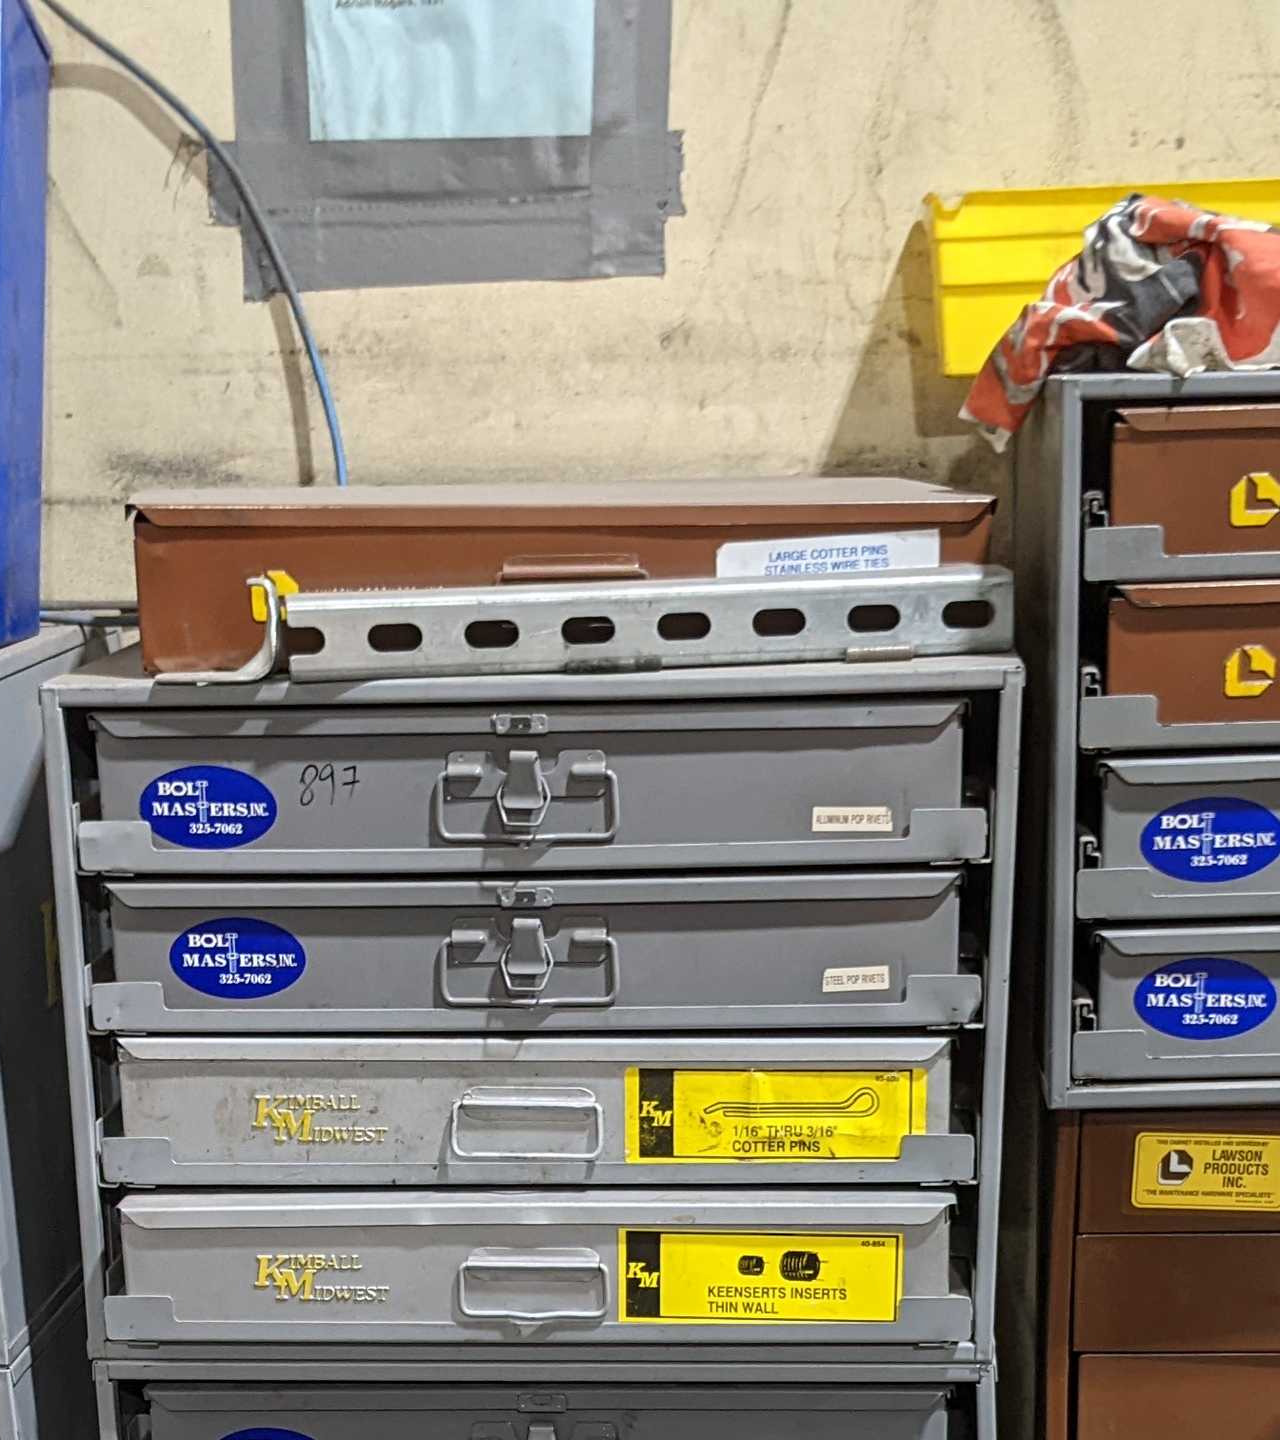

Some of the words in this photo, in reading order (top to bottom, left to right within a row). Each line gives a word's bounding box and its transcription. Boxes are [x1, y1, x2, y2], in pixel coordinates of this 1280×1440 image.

[769, 550, 807, 562] LARGE
[810, 548, 858, 560] COTTER
[861, 545, 887, 555] PINS
[765, 562, 828, 576] STAINLESS
[831, 560, 859, 570] WIRE
[864, 558, 890, 568] TIES
[300, 764, 360, 806] 897
[189, 823, 243, 835] 325-7062
[1190, 854, 1248, 866] 325-7062
[219, 973, 272, 985] 325-7062
[825, 975, 845, 986] STEEL
[847, 974, 860, 985] POP
[862, 973, 885, 984] RIVETS
[252, 1094, 360, 1131] KIMBALL
[274, 1109, 388, 1144] MIDWEST
[766, 1124, 803, 1137] THRU
[732, 1139, 787, 1153] COTTER
[790, 1140, 820, 1152] PINS
[1212, 1150, 1262, 1162] LAWSON
[1203, 1163, 1269, 1175] PRODUCTS
[1222, 1176, 1246, 1188] INC.
[707, 1286, 786, 1300] KEENSERTS
[790, 1287, 847, 1300] INSERTS
[707, 1300, 739, 1314] THIN
[742, 1301, 779, 1314] WALL
